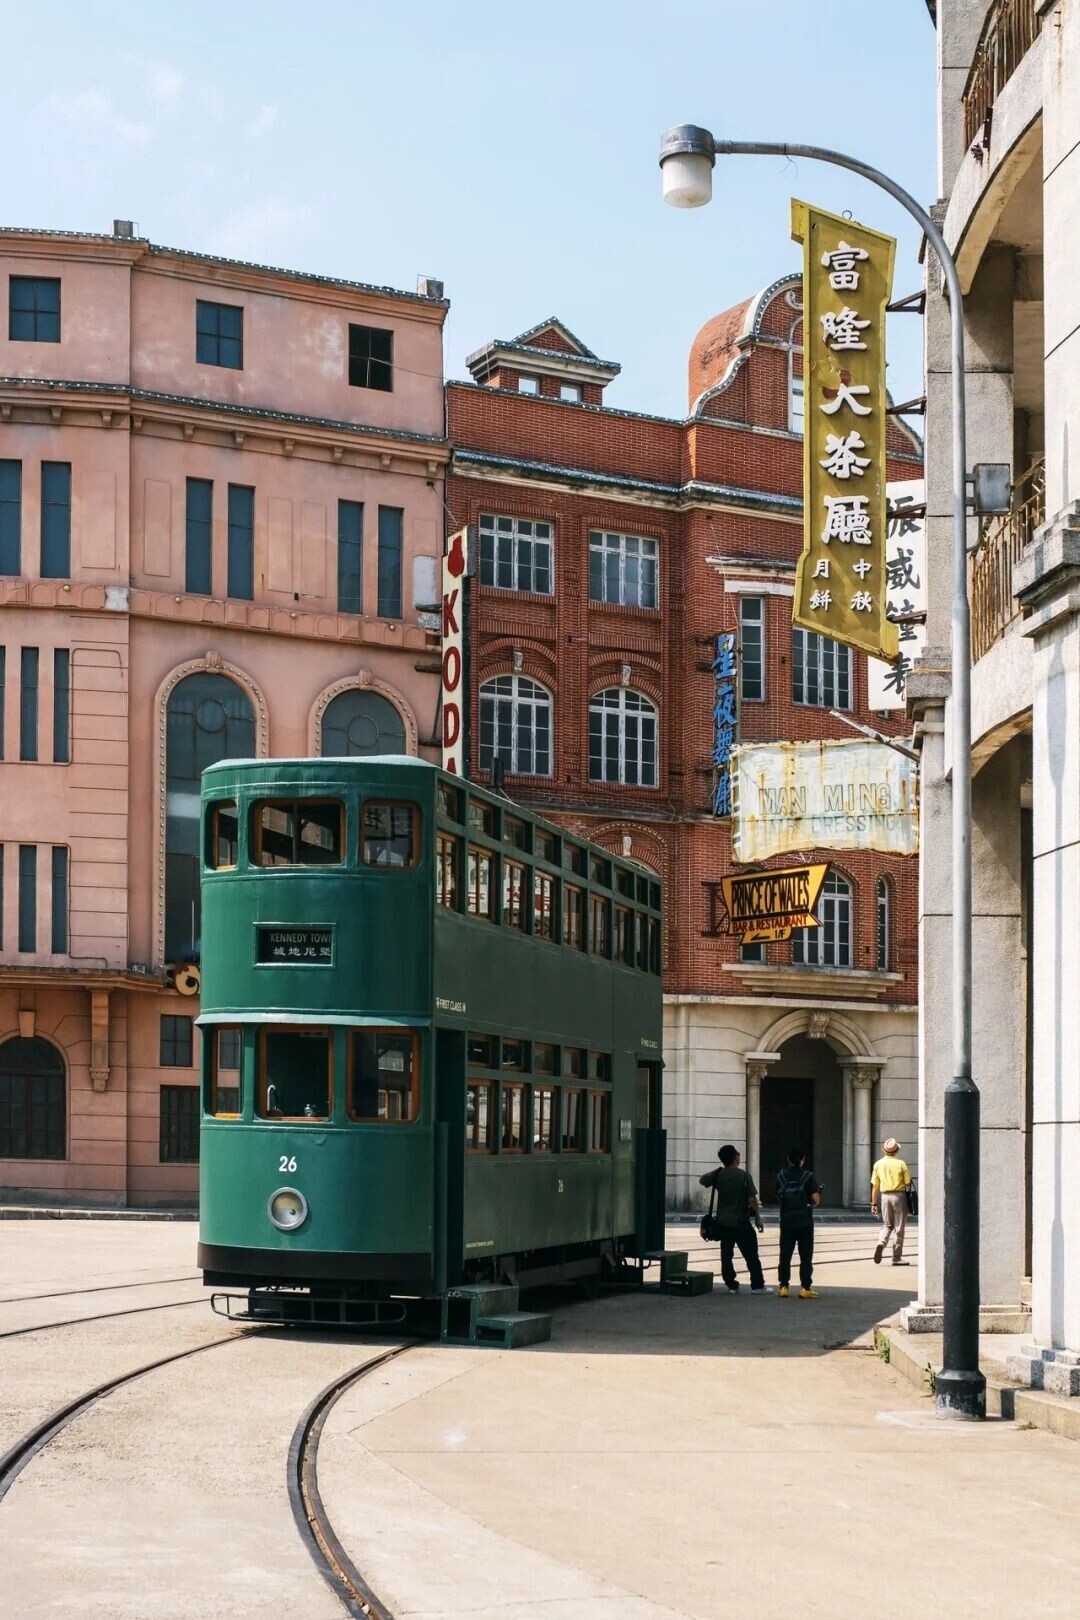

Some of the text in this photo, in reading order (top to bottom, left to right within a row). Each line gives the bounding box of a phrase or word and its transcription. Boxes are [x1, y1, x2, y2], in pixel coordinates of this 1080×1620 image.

[809, 558, 832, 611] 月餅
[850, 558, 873, 613] 中秋
[823, 782, 891, 812] MING
[732, 875, 810, 917] PRINCE OF WALES
[270, 933, 307, 943] KENNEDY
[732, 921, 748, 933] BAR
[756, 914, 808, 930] RESTAURANT
[279, 1155, 297, 1173] 26
